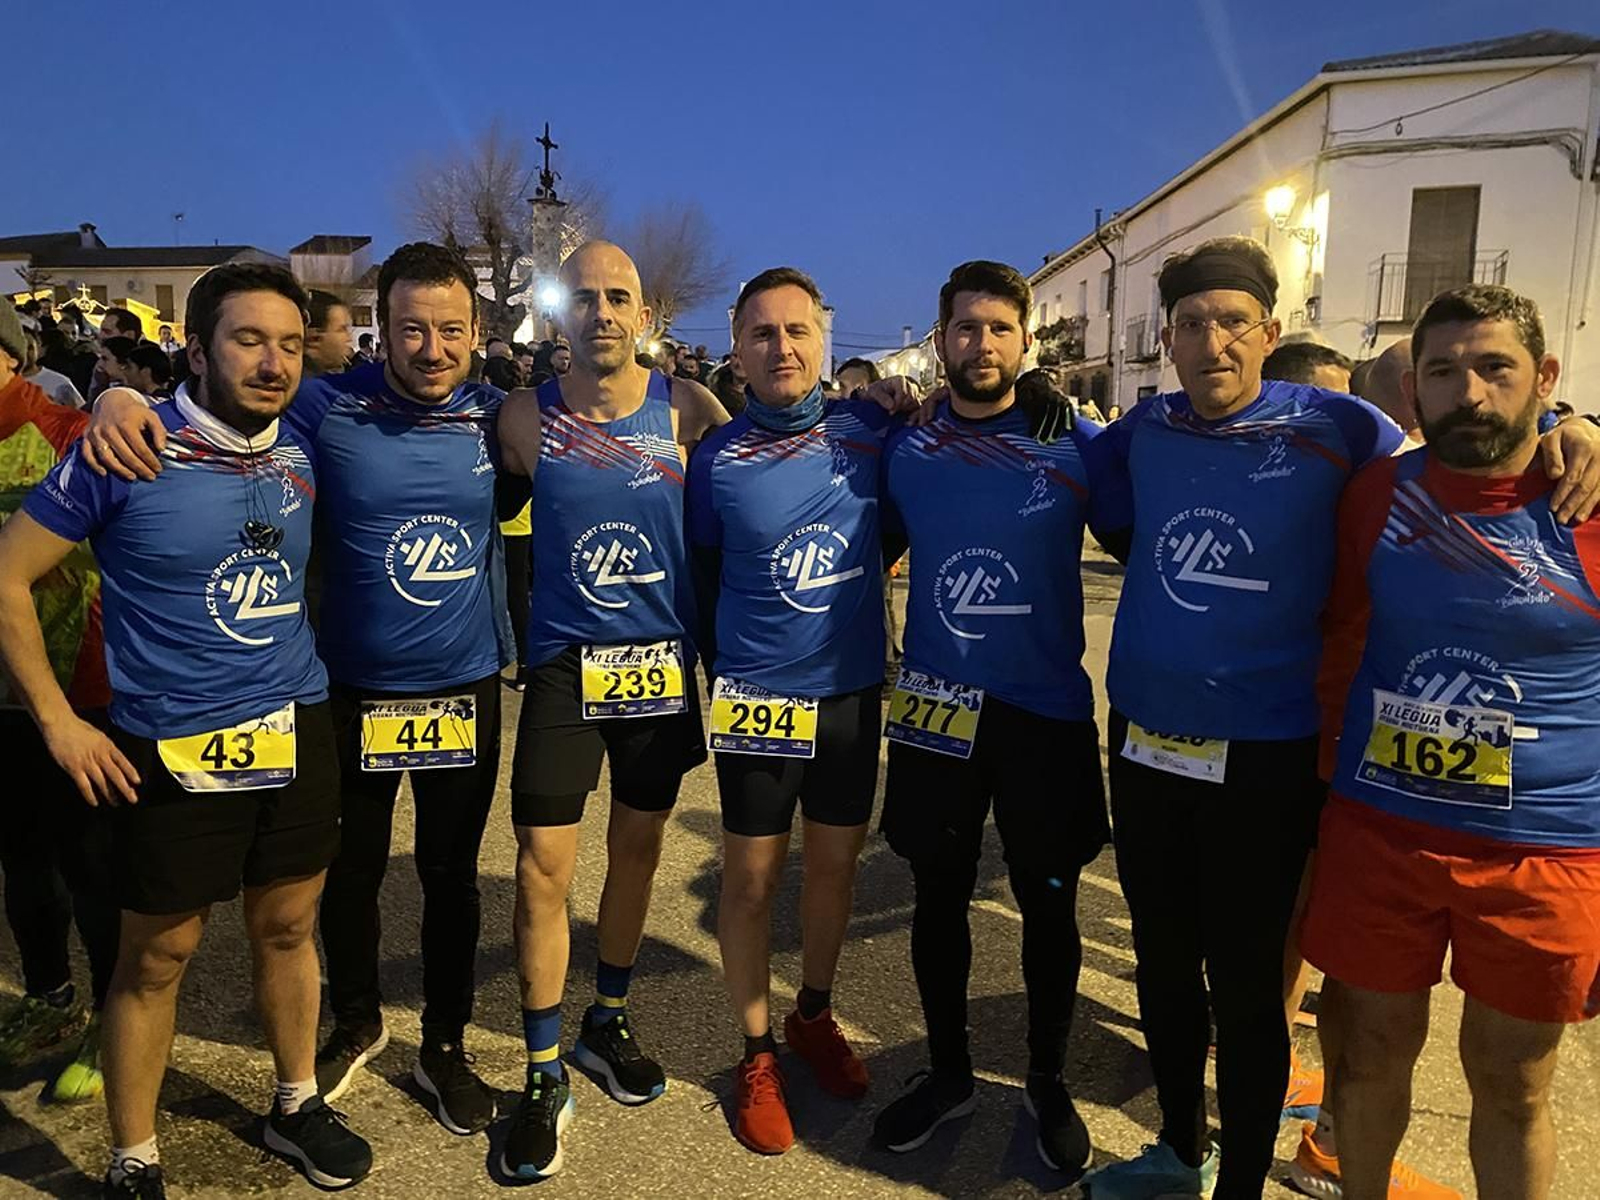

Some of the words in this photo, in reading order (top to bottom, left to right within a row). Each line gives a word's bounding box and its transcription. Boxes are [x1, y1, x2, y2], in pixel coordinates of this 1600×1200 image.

[574, 526, 599, 551] SPORT
[600, 522, 637, 534] CENTER
[772, 533, 794, 560] SPORT
[795, 523, 830, 537] CENTER
[1154, 537, 1166, 571] ACTIVA
[1162, 510, 1190, 535] SPORT
[1193, 508, 1236, 526] CENTER
[384, 543, 396, 576] ACTIVA
[391, 518, 419, 543] SPORT
[420, 515, 459, 529] CENTER
[211, 553, 239, 580] SPORT
[570, 552, 580, 582] ACTIVA
[933, 577, 943, 609] ACTIVA
[939, 551, 963, 575] SPORT
[965, 548, 1003, 561] CENTER
[589, 653, 603, 663] XI
[604, 651, 644, 664] LEGUA
[1406, 648, 1439, 675] SPORT
[1443, 647, 1500, 672] CENTER
[603, 668, 666, 701] 239
[720, 684, 734, 694] XI
[386, 704, 427, 713] LEGUA
[729, 703, 796, 738] 294
[901, 695, 960, 734] 277
[1379, 701, 1394, 716] XI
[1394, 705, 1441, 727] LEGUA
[200, 733, 256, 769] 43
[395, 719, 443, 751] 44
[1390, 731, 1478, 782] 162
